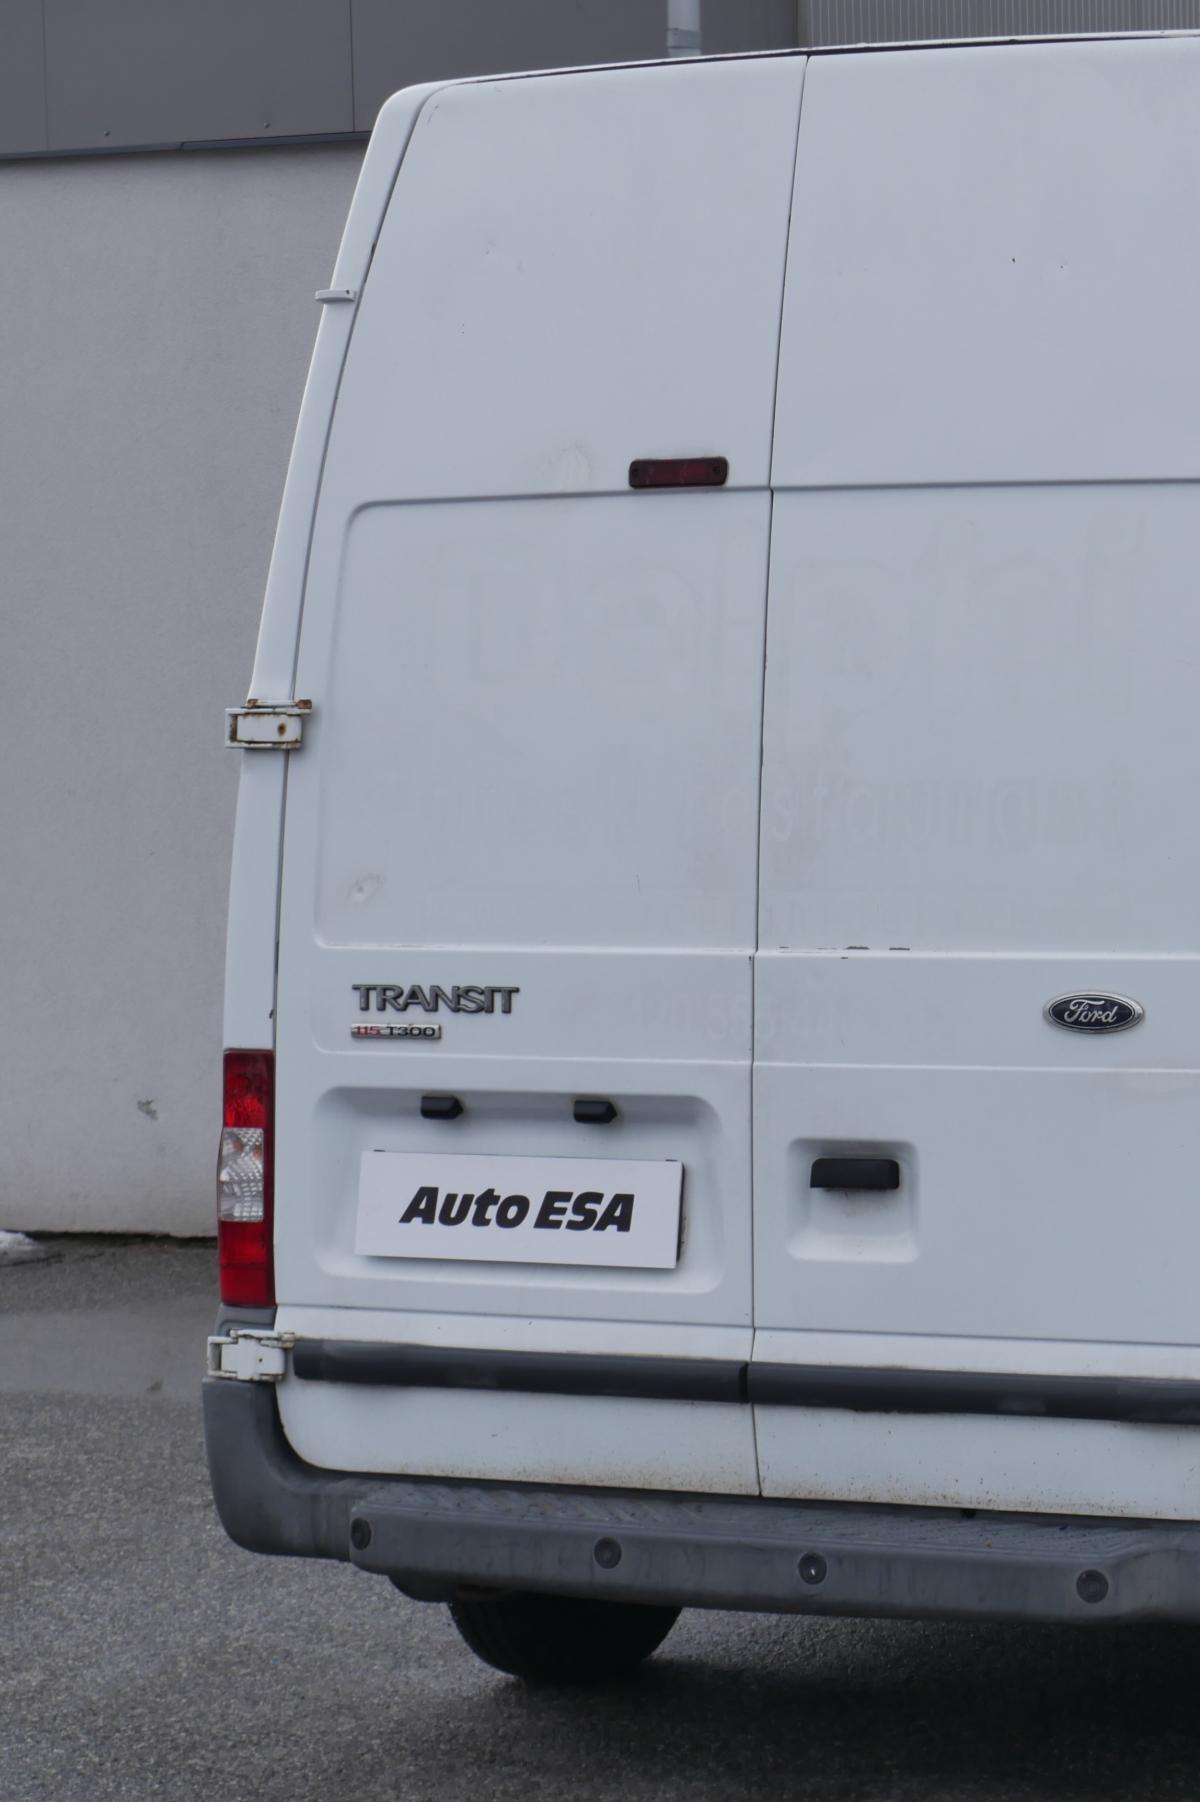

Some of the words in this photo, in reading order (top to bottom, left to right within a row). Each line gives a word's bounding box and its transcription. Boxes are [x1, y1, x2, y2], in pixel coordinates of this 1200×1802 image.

[351, 983, 520, 1014] TRANSIT
[1063, 999, 1119, 1023] Ford
[386, 1026, 436, 1037] T300
[398, 1186, 531, 1229] Auto
[532, 1190, 636, 1233] ESA
